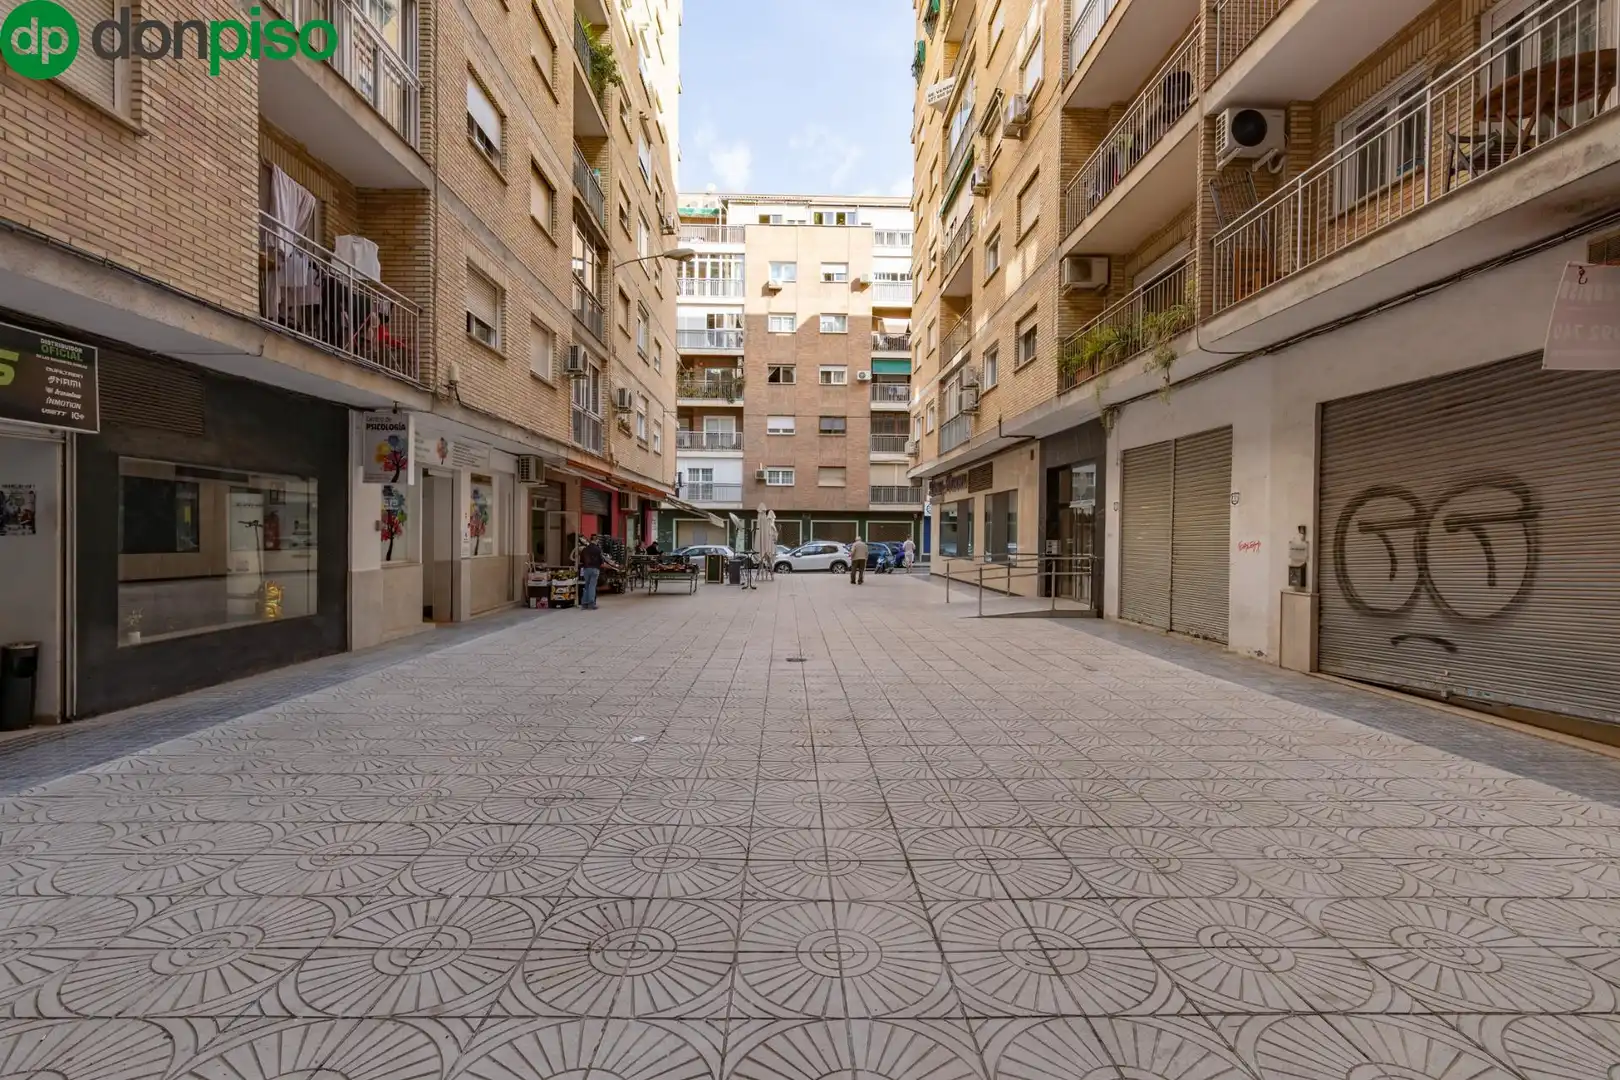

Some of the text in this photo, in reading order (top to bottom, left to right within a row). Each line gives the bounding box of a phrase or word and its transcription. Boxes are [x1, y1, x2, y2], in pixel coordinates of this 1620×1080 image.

[40, 338, 83, 354] DISTRIBUIDOR
[41, 344, 84, 362] OFICIAL
[365, 421, 406, 431] PSICOLOGÍA
